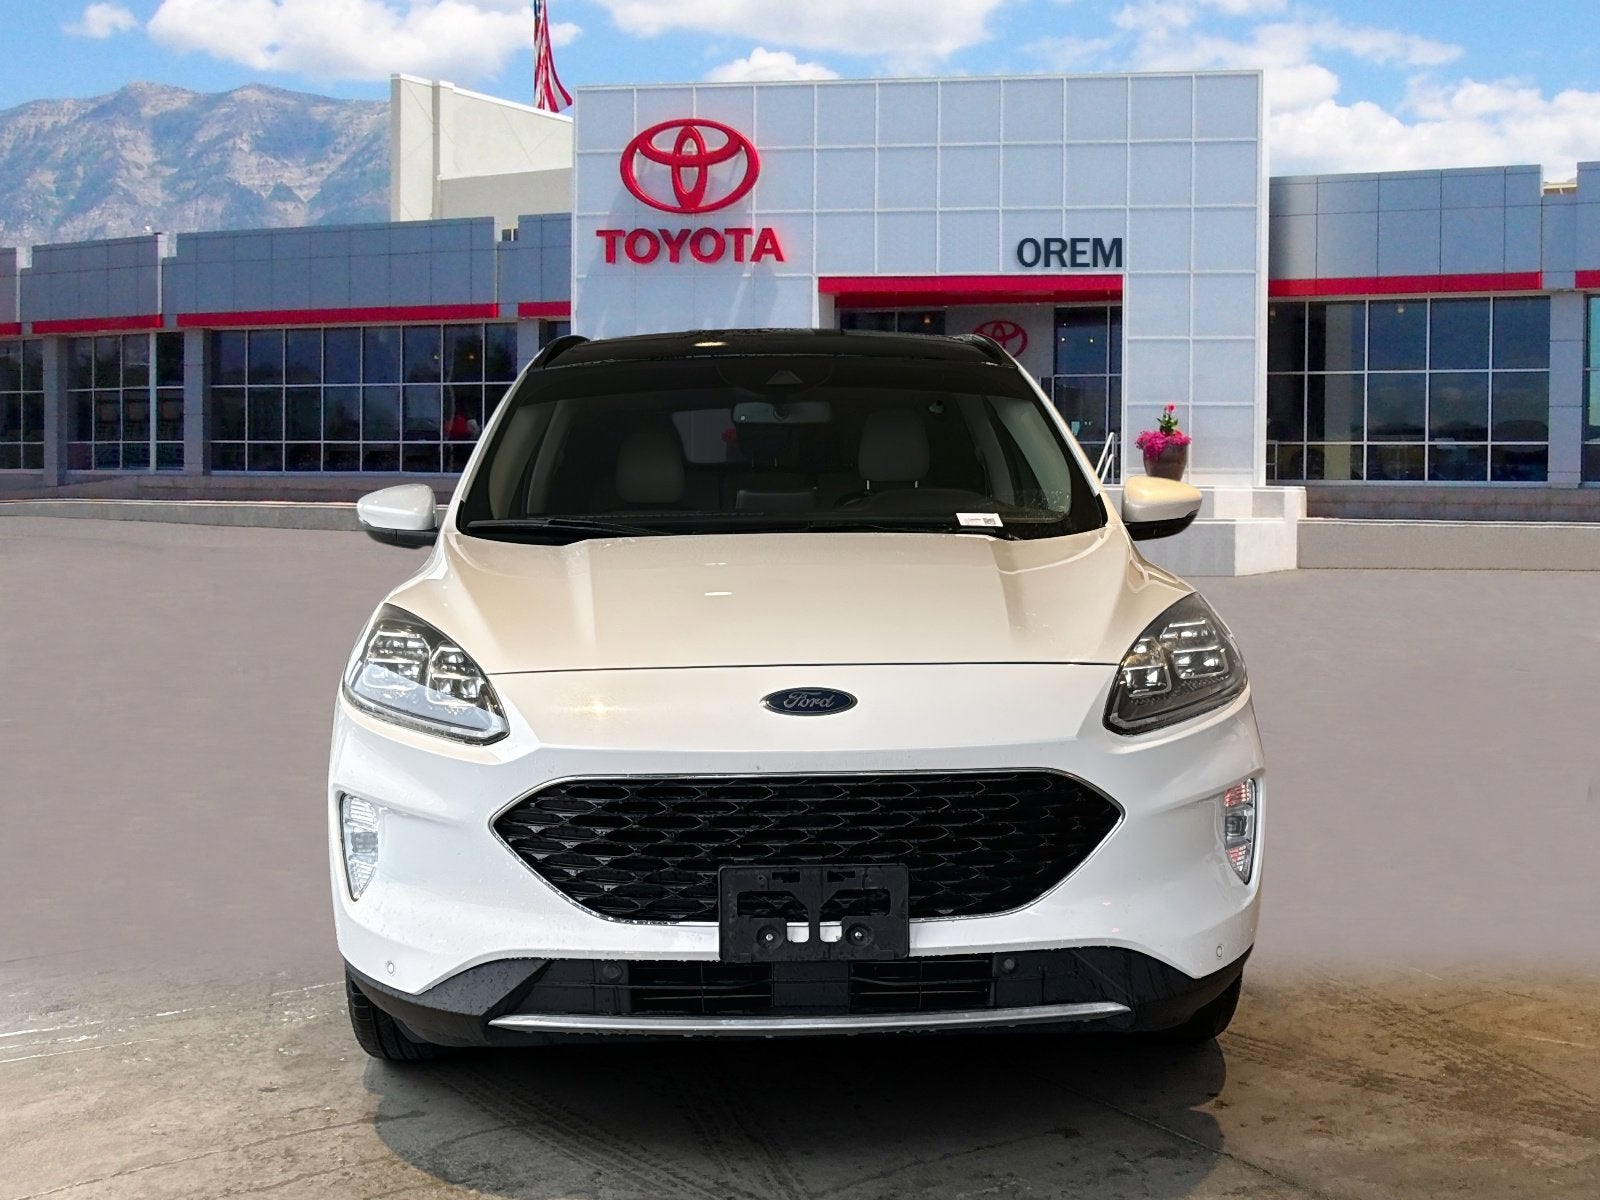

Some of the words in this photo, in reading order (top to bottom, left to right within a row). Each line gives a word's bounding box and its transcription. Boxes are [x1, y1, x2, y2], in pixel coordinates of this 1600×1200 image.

[595, 227, 785, 265] TOYOTA
[1016, 237, 1123, 269] OREM
[783, 691, 836, 709] Ford
